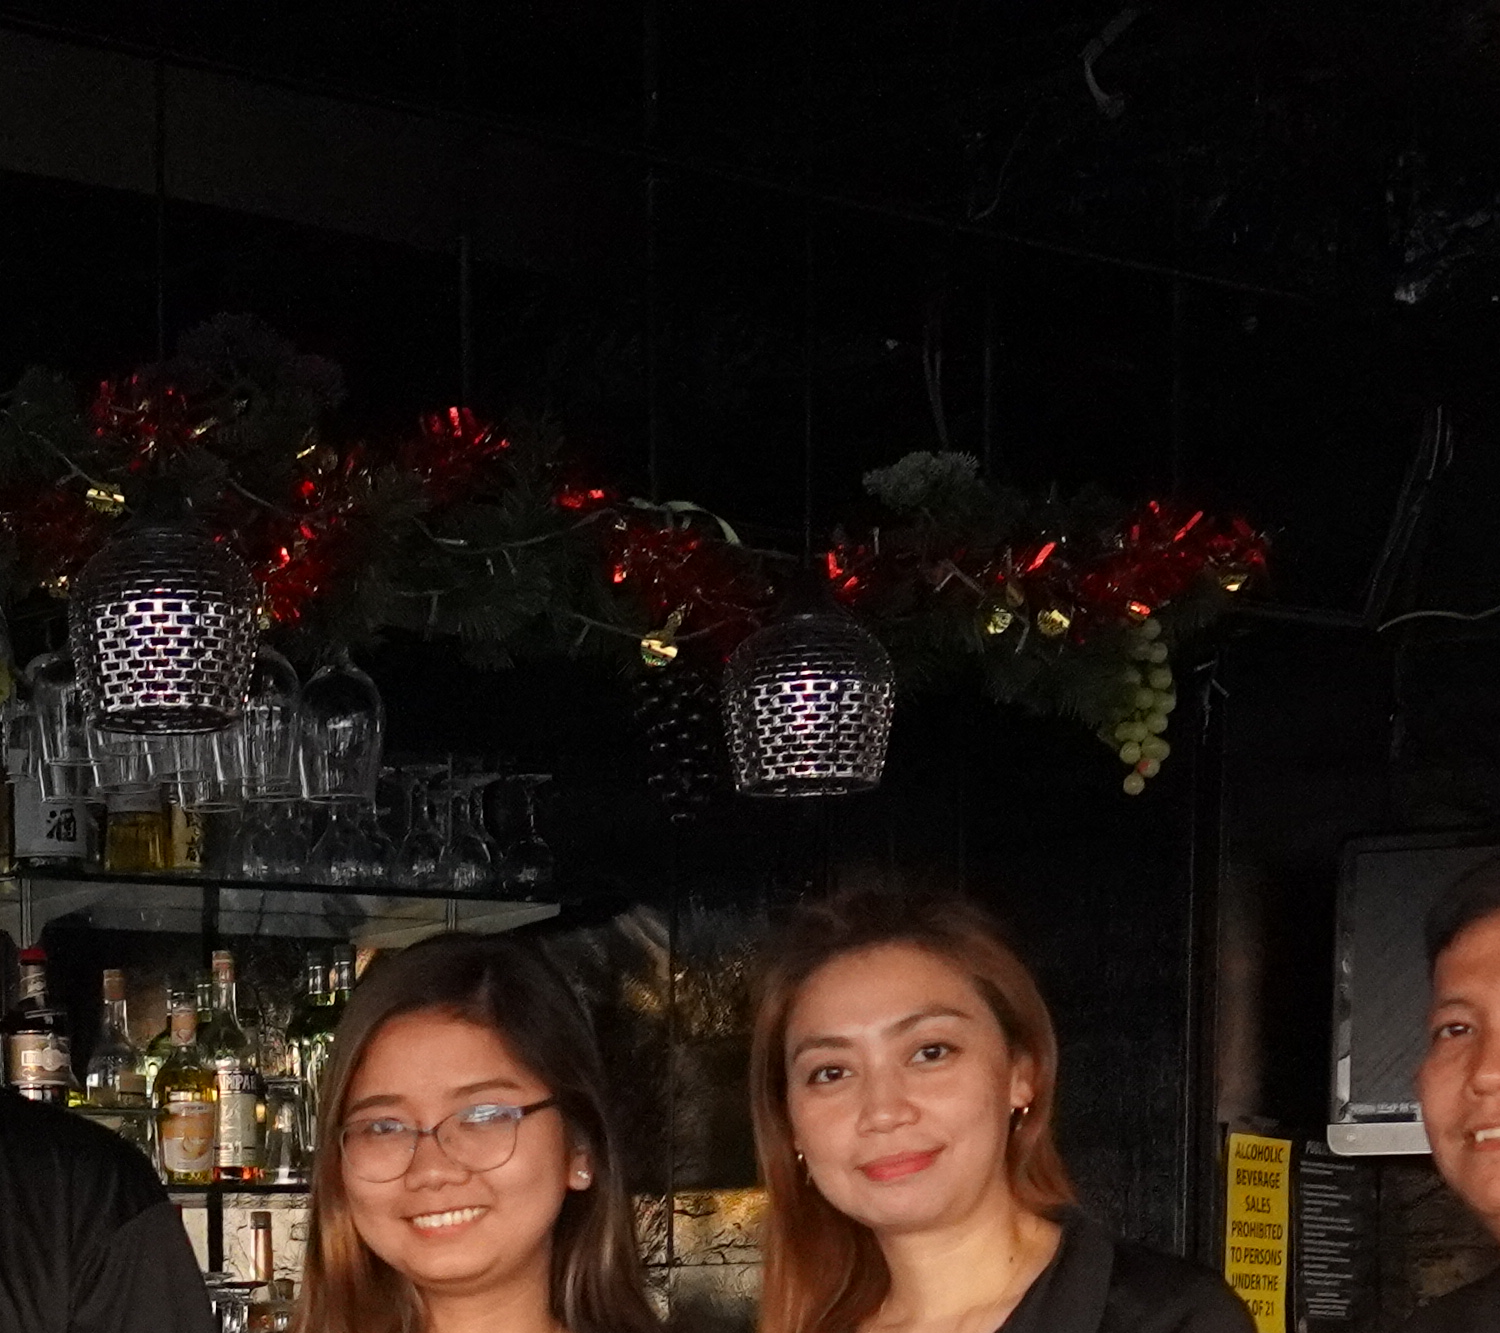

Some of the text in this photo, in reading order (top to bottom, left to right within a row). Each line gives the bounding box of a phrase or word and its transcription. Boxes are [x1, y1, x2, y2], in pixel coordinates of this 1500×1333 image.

[1234, 1142, 1285, 1164] ALCOHOLIC
[1236, 1168, 1281, 1189] BEVERAGE
[1244, 1196, 1271, 1214] SALES
[1231, 1220, 1284, 1241] PROHIBITED
[1231, 1247, 1282, 1267] TO PERSONS
[1231, 1273, 1279, 1292] UNDER THE
[1252, 1299, 1275, 1316] OF 21
